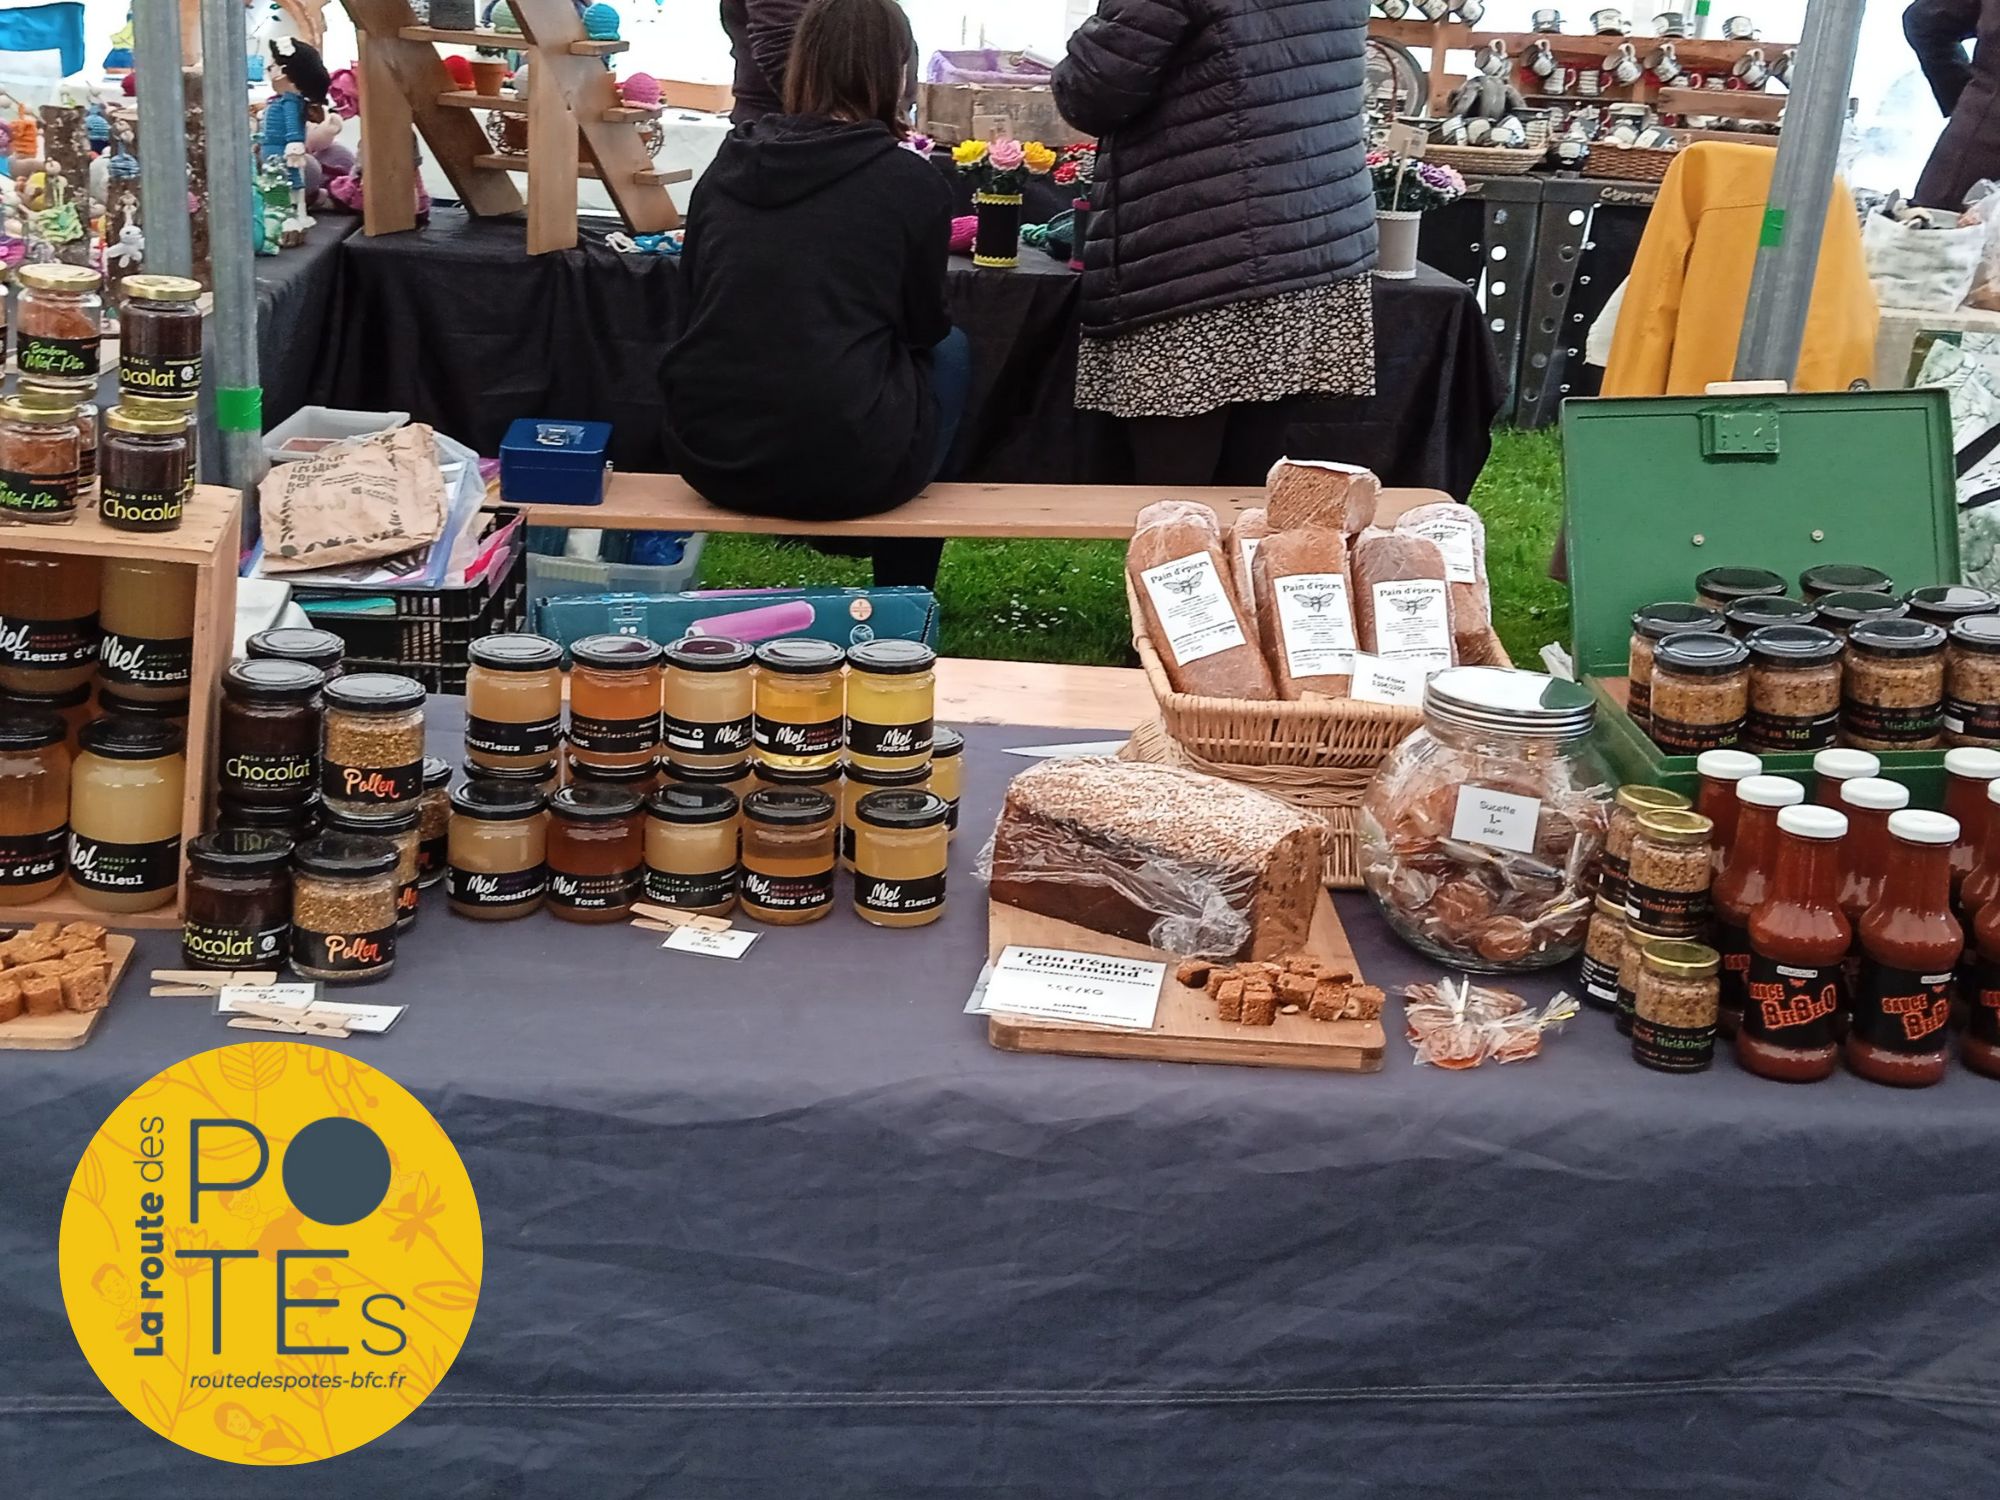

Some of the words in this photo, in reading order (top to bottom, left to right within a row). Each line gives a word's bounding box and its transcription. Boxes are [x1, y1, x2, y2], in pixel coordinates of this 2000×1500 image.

[120, 367, 176, 387] ocolat
[1379, 586, 1402, 597] Pain
[13, 649, 68, 662] Fleurs
[129, 668, 189, 681] Tilleul
[775, 726, 806, 746] Miel
[882, 728, 913, 747] Miel
[226, 758, 311, 781] Chocolat
[342, 768, 400, 799] Pollen
[1479, 800, 1517, 815] Sucette
[83, 869, 145, 886] Tilleul
[466, 874, 499, 895] Miel
[552, 876, 579, 897] Miel
[871, 882, 902, 902] Miel
[324, 935, 383, 963] Pollen
[1026, 959, 1139, 978] Gourmand
[1882, 993, 1929, 1014] SAUCE
